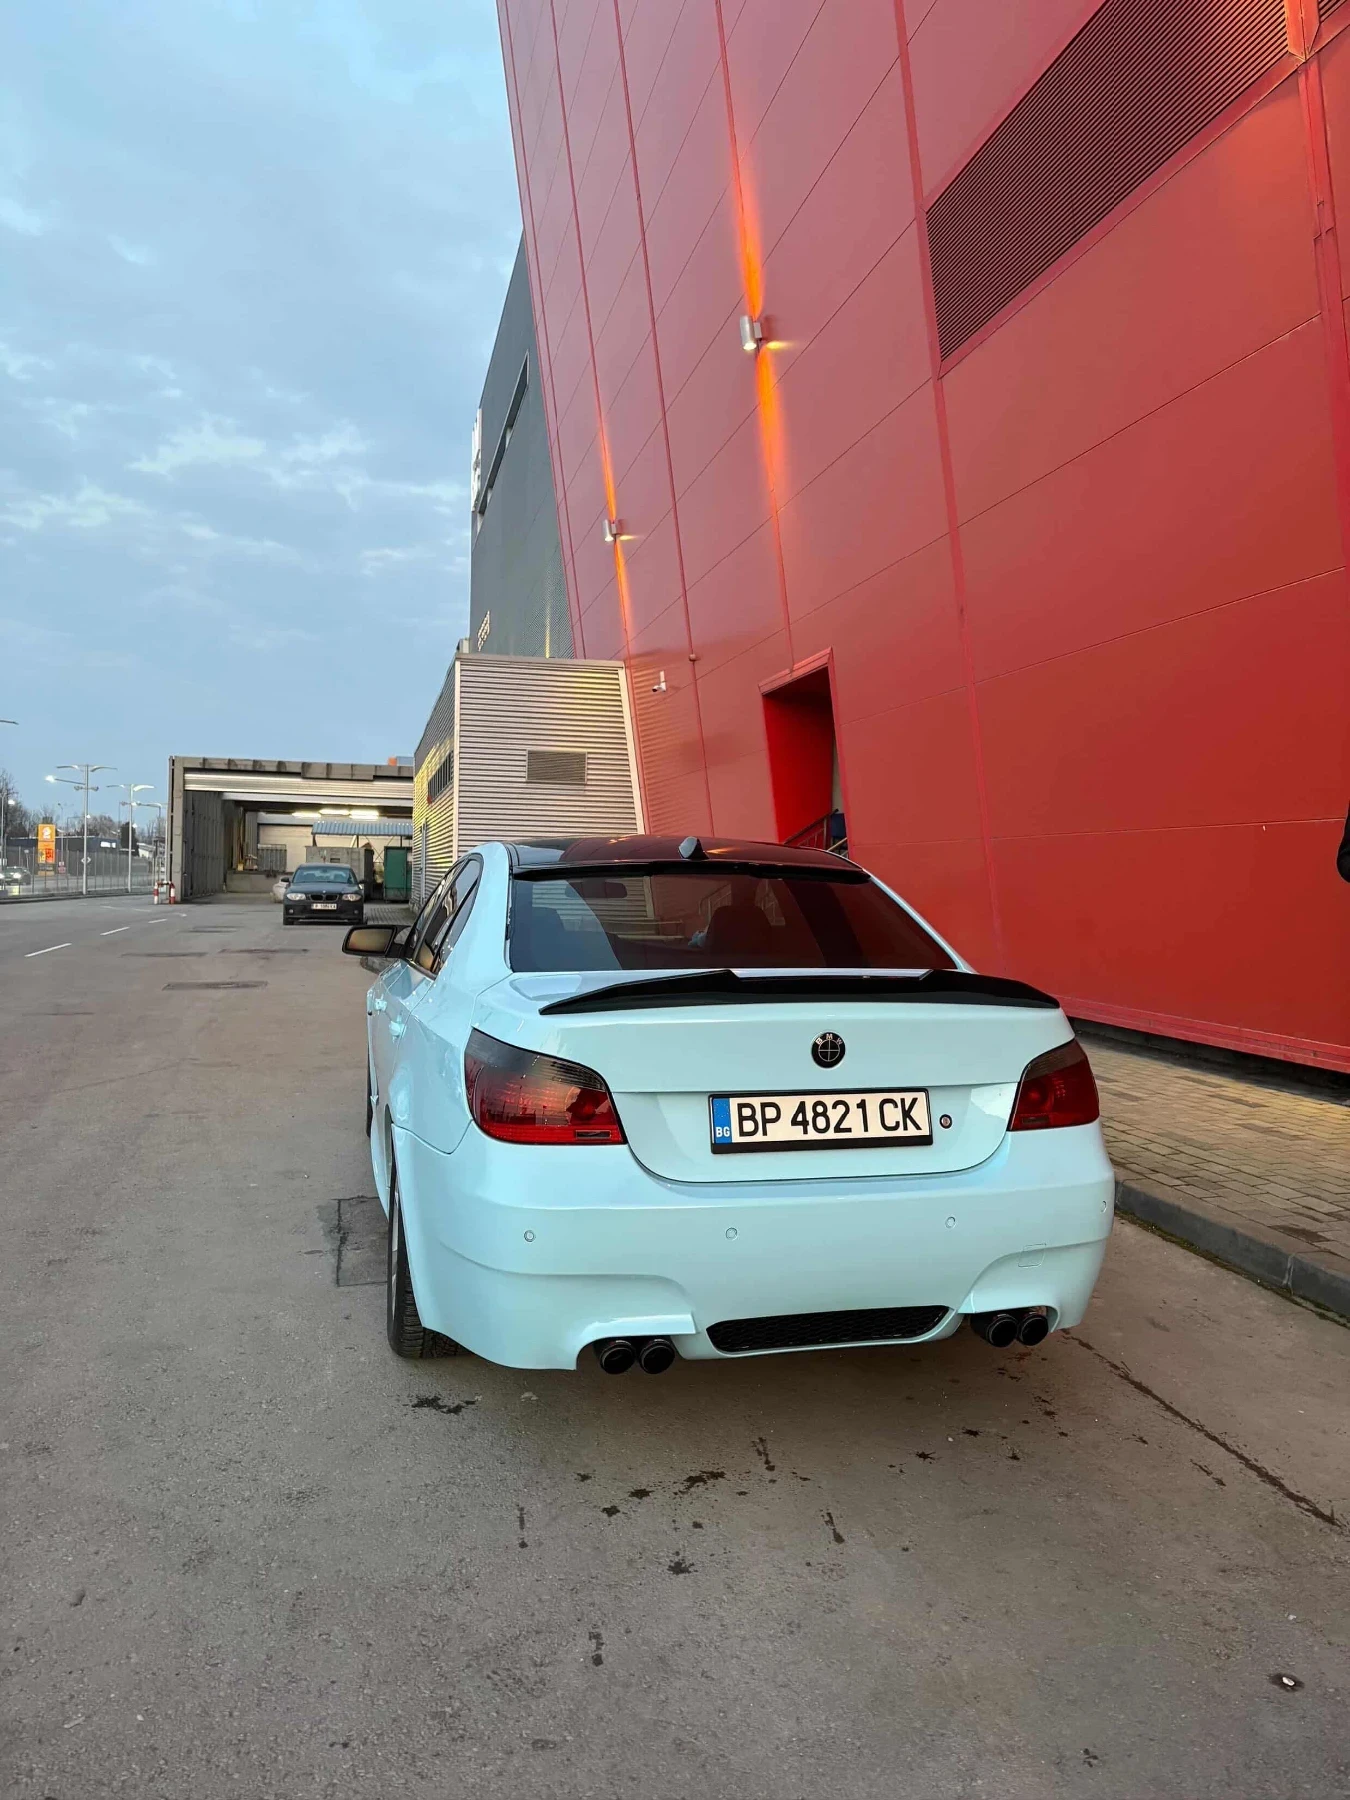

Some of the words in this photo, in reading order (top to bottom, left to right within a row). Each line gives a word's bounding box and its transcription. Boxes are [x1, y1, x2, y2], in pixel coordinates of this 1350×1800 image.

[815, 1033, 843, 1046] BMW
[737, 1102, 782, 1137] BP
[790, 1099, 869, 1135] 4821
[878, 1097, 923, 1132] CK
[715, 1126, 731, 1138] BG
